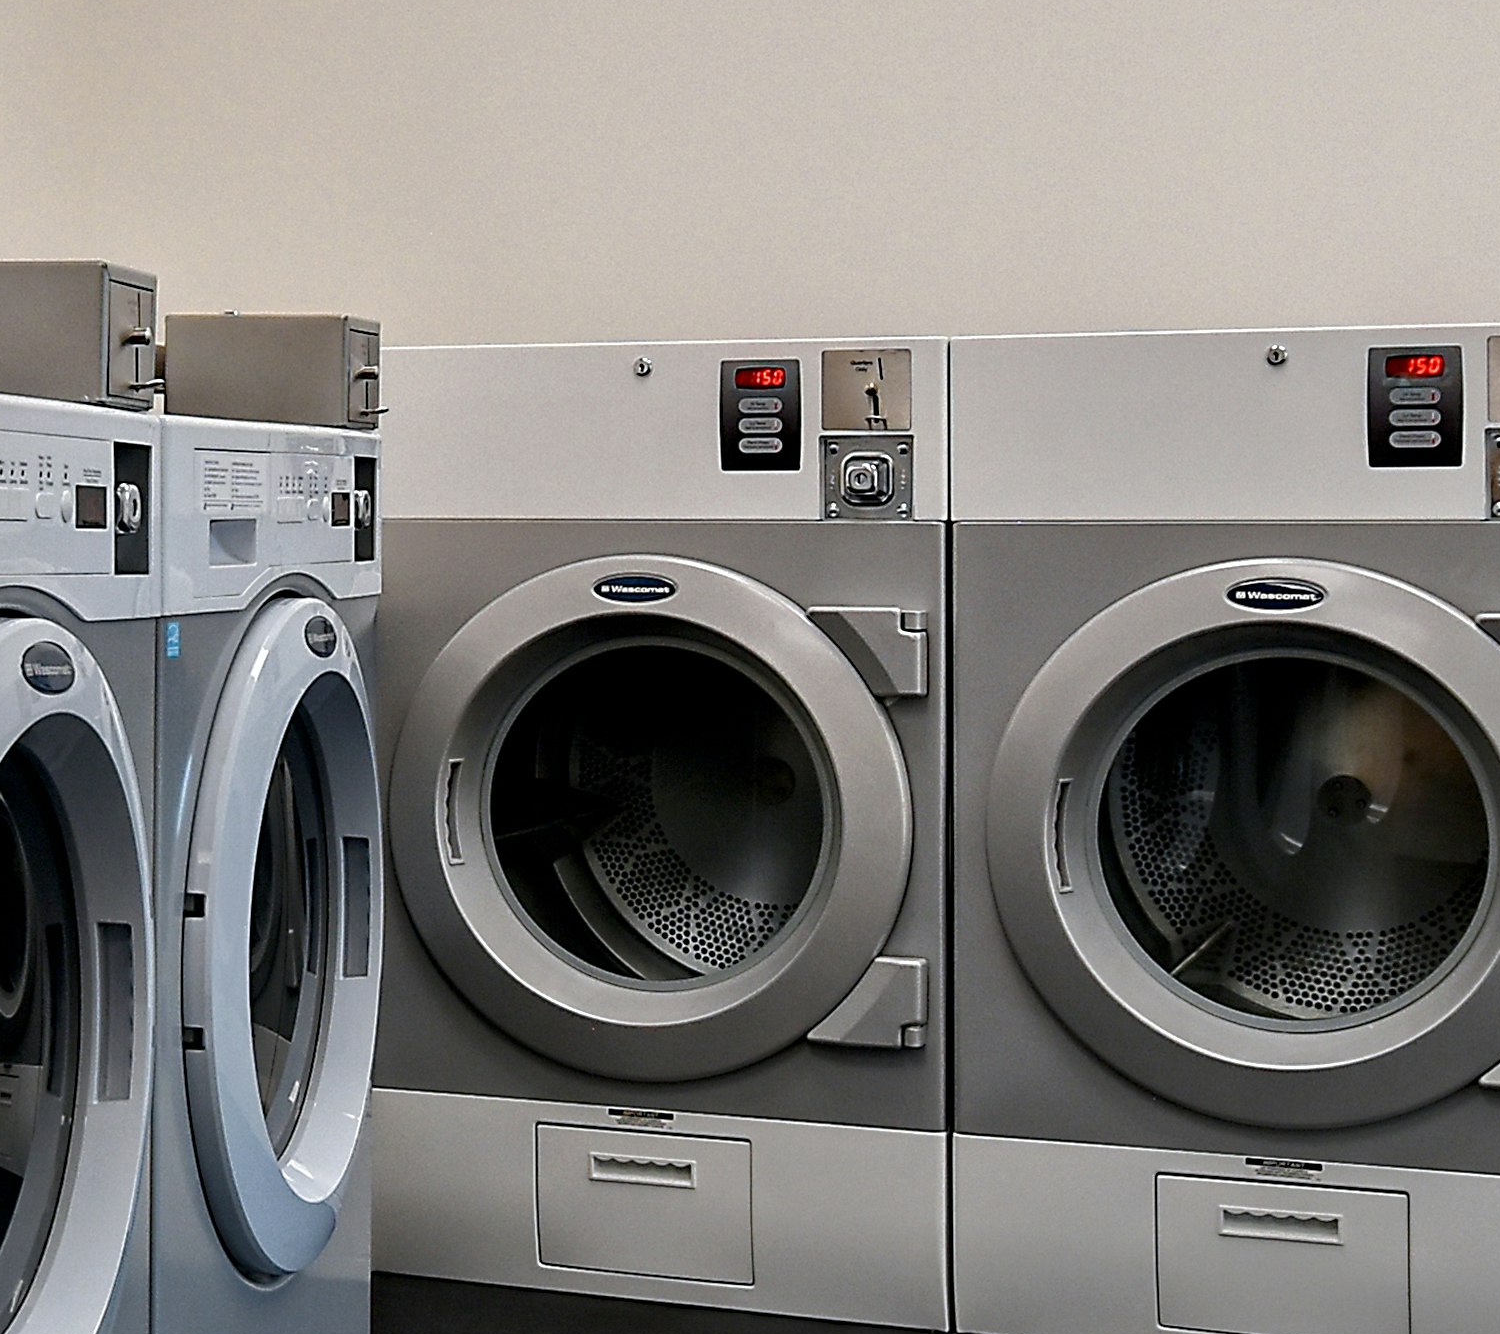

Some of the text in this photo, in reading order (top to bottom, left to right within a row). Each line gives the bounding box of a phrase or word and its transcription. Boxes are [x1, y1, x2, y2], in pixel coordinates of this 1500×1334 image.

[1408, 355, 1441, 375] 150
[756, 369, 784, 386] 150
[611, 584, 670, 594] Wascomat
[1247, 590, 1316, 602] Wascomat
